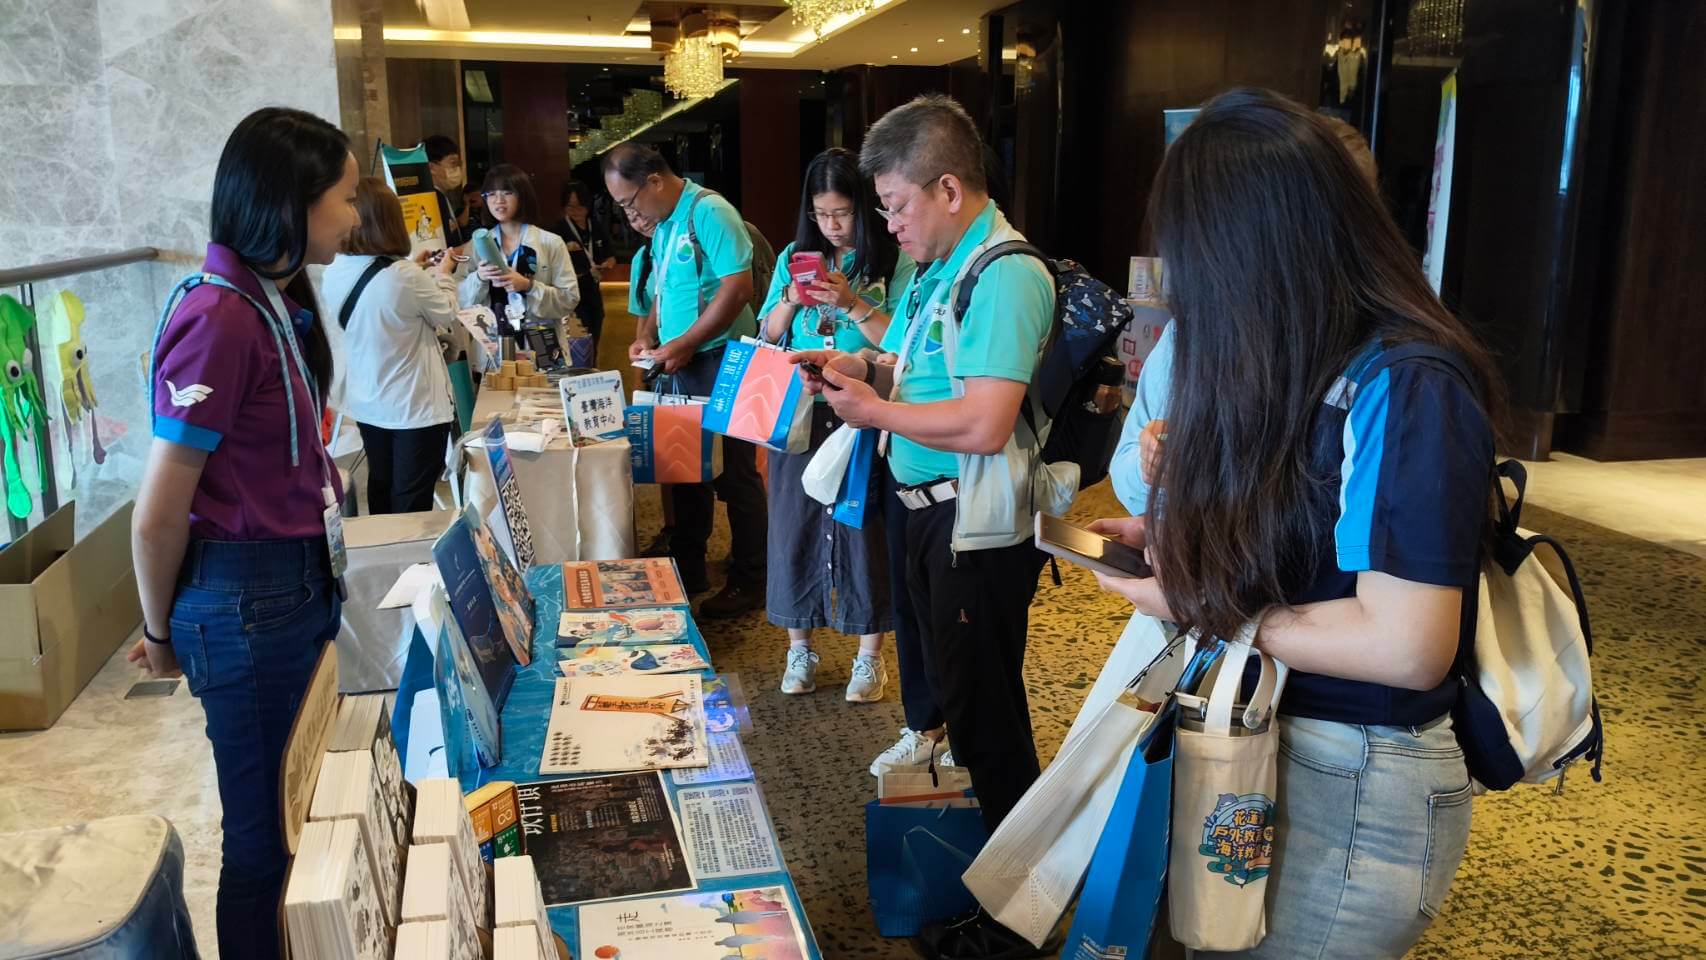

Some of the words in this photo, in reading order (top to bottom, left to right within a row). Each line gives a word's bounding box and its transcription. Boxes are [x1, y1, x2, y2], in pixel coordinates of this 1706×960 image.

[581, 397, 613, 414] 臺灣海洋
[584, 414, 616, 431] 教育中心
